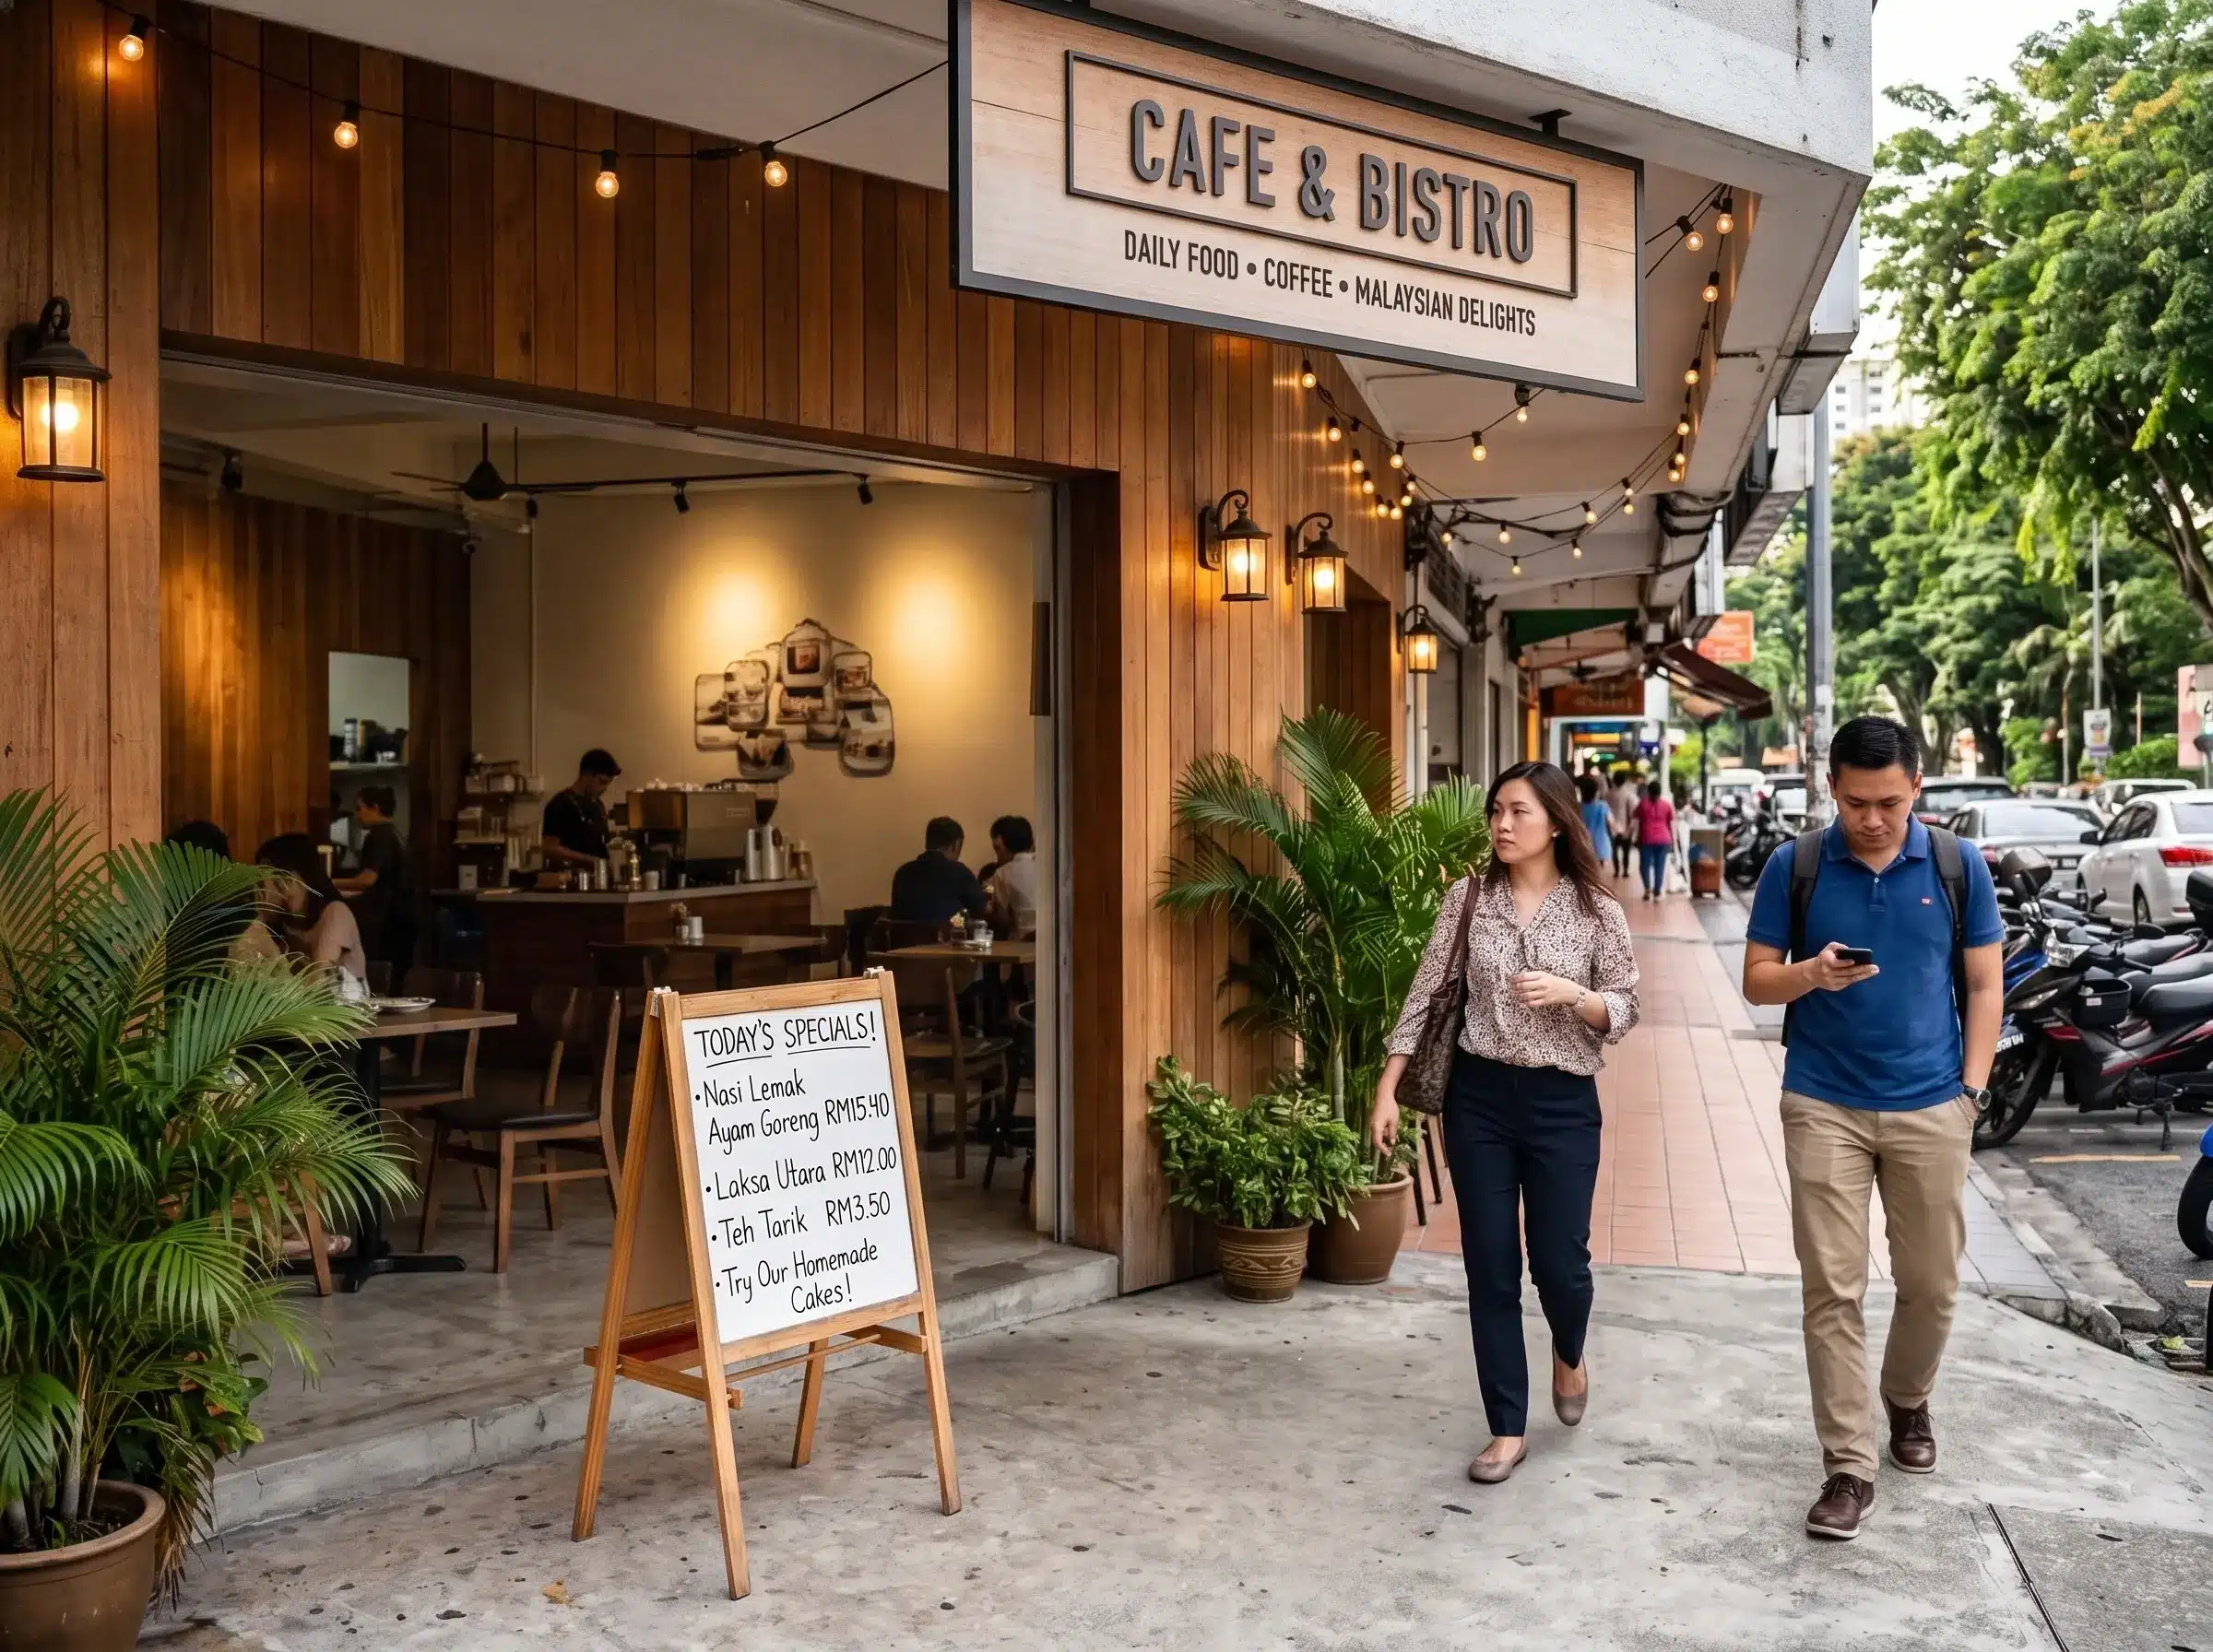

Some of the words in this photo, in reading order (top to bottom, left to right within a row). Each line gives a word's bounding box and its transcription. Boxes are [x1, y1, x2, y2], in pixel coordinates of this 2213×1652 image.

[1130, 100, 1276, 209] CAFE
[1297, 146, 1336, 222] &
[1358, 153, 1533, 265] BISTRO
[1124, 230, 1181, 269] DAILY
[1188, 242, 1239, 280] FOOD
[1264, 257, 1333, 299] COFFEE
[1355, 276, 1454, 321] MALAYSIAN
[1459, 296, 1536, 336] DELIGHTS
[693, 1018, 775, 1057] TODAY'S
[784, 1010, 876, 1048] SPECIALS!
[703, 1079, 742, 1108] Nasi
[749, 1068, 807, 1103] Lemak
[708, 1116, 755, 1156] Ayam
[760, 1108, 820, 1142] Goreng
[824, 1092, 891, 1127] RM15.40
[715, 1168, 771, 1201] Laksa
[775, 1158, 827, 1190] Utara
[832, 1146, 897, 1179] RM12.00
[717, 1215, 755, 1249] Teh
[757, 1205, 809, 1239] Tarik
[825, 1190, 892, 1227] RM3.50
[720, 1265, 753, 1304] Try
[757, 1259, 789, 1288] Our
[792, 1237, 879, 1280] Homemade
[791, 1272, 853, 1315] Cakes!
